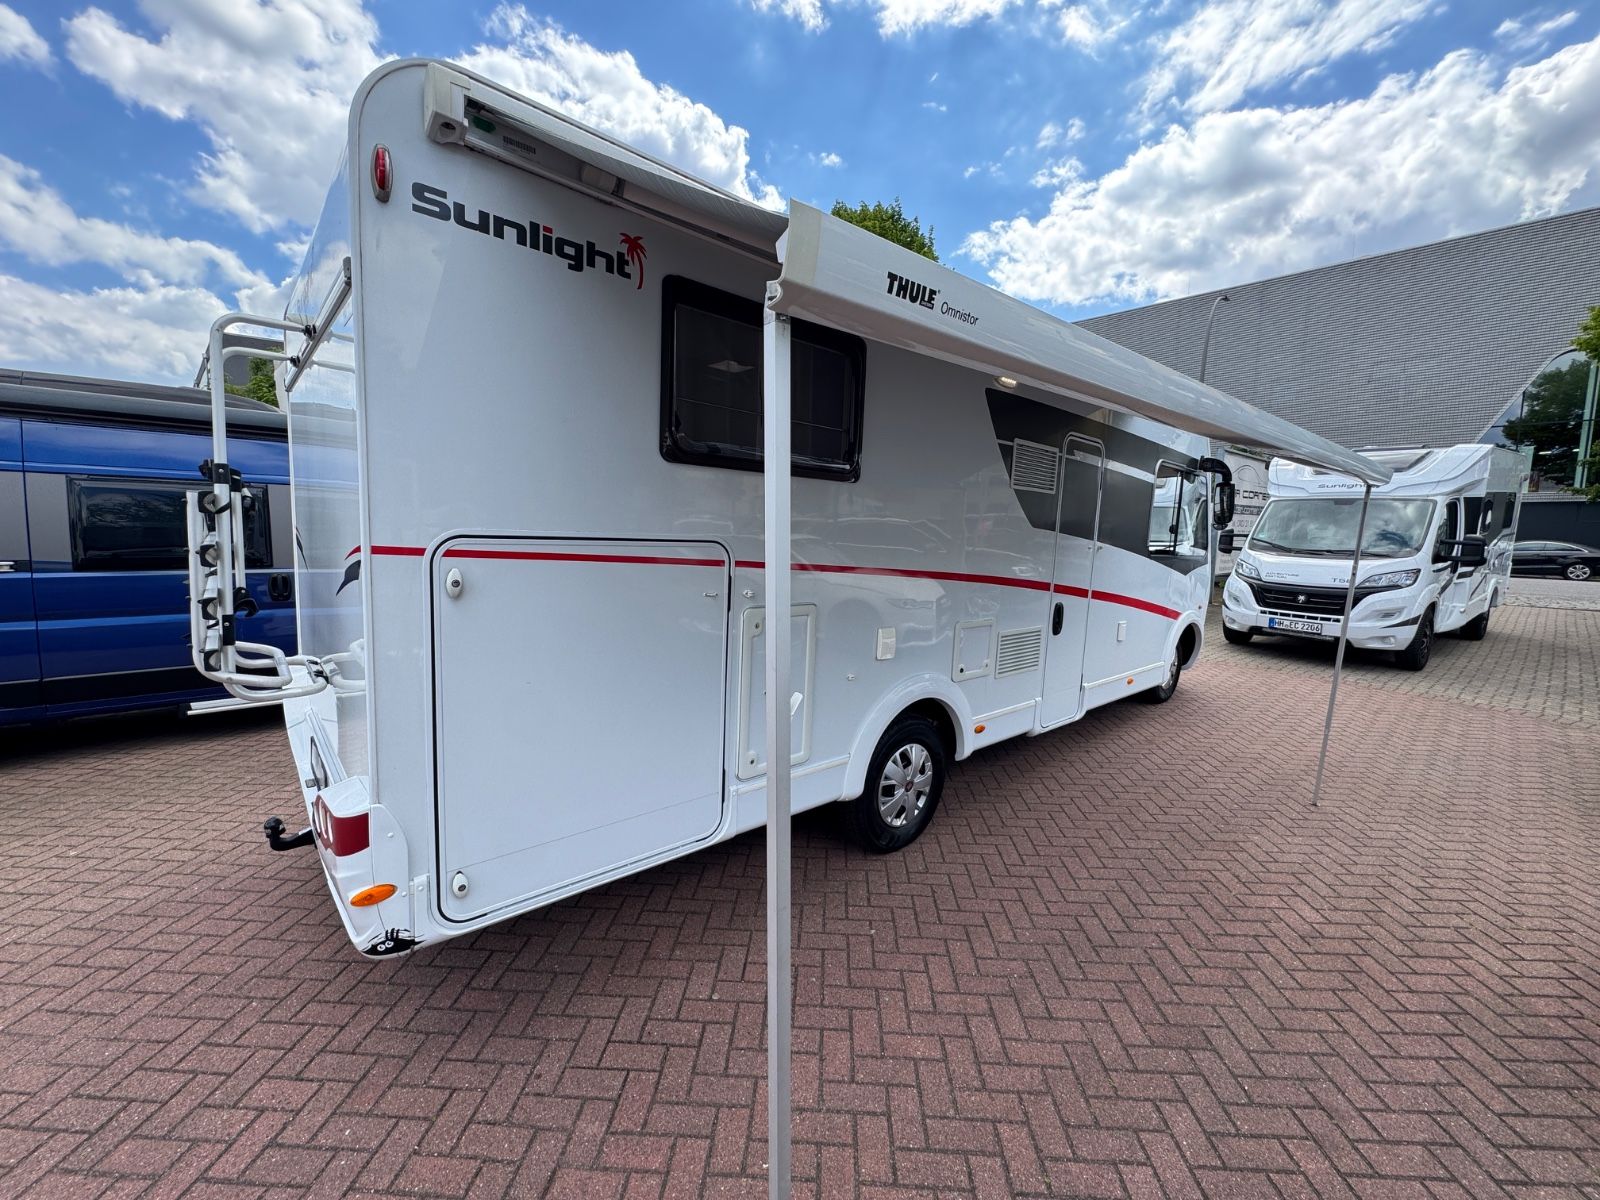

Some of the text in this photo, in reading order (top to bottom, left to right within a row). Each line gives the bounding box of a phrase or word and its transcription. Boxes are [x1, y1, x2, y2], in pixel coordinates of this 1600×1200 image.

[411, 182, 632, 280] Sunlight
[887, 271, 979, 325] THULE Omnistor
[1290, 621, 1299, 629] EC
